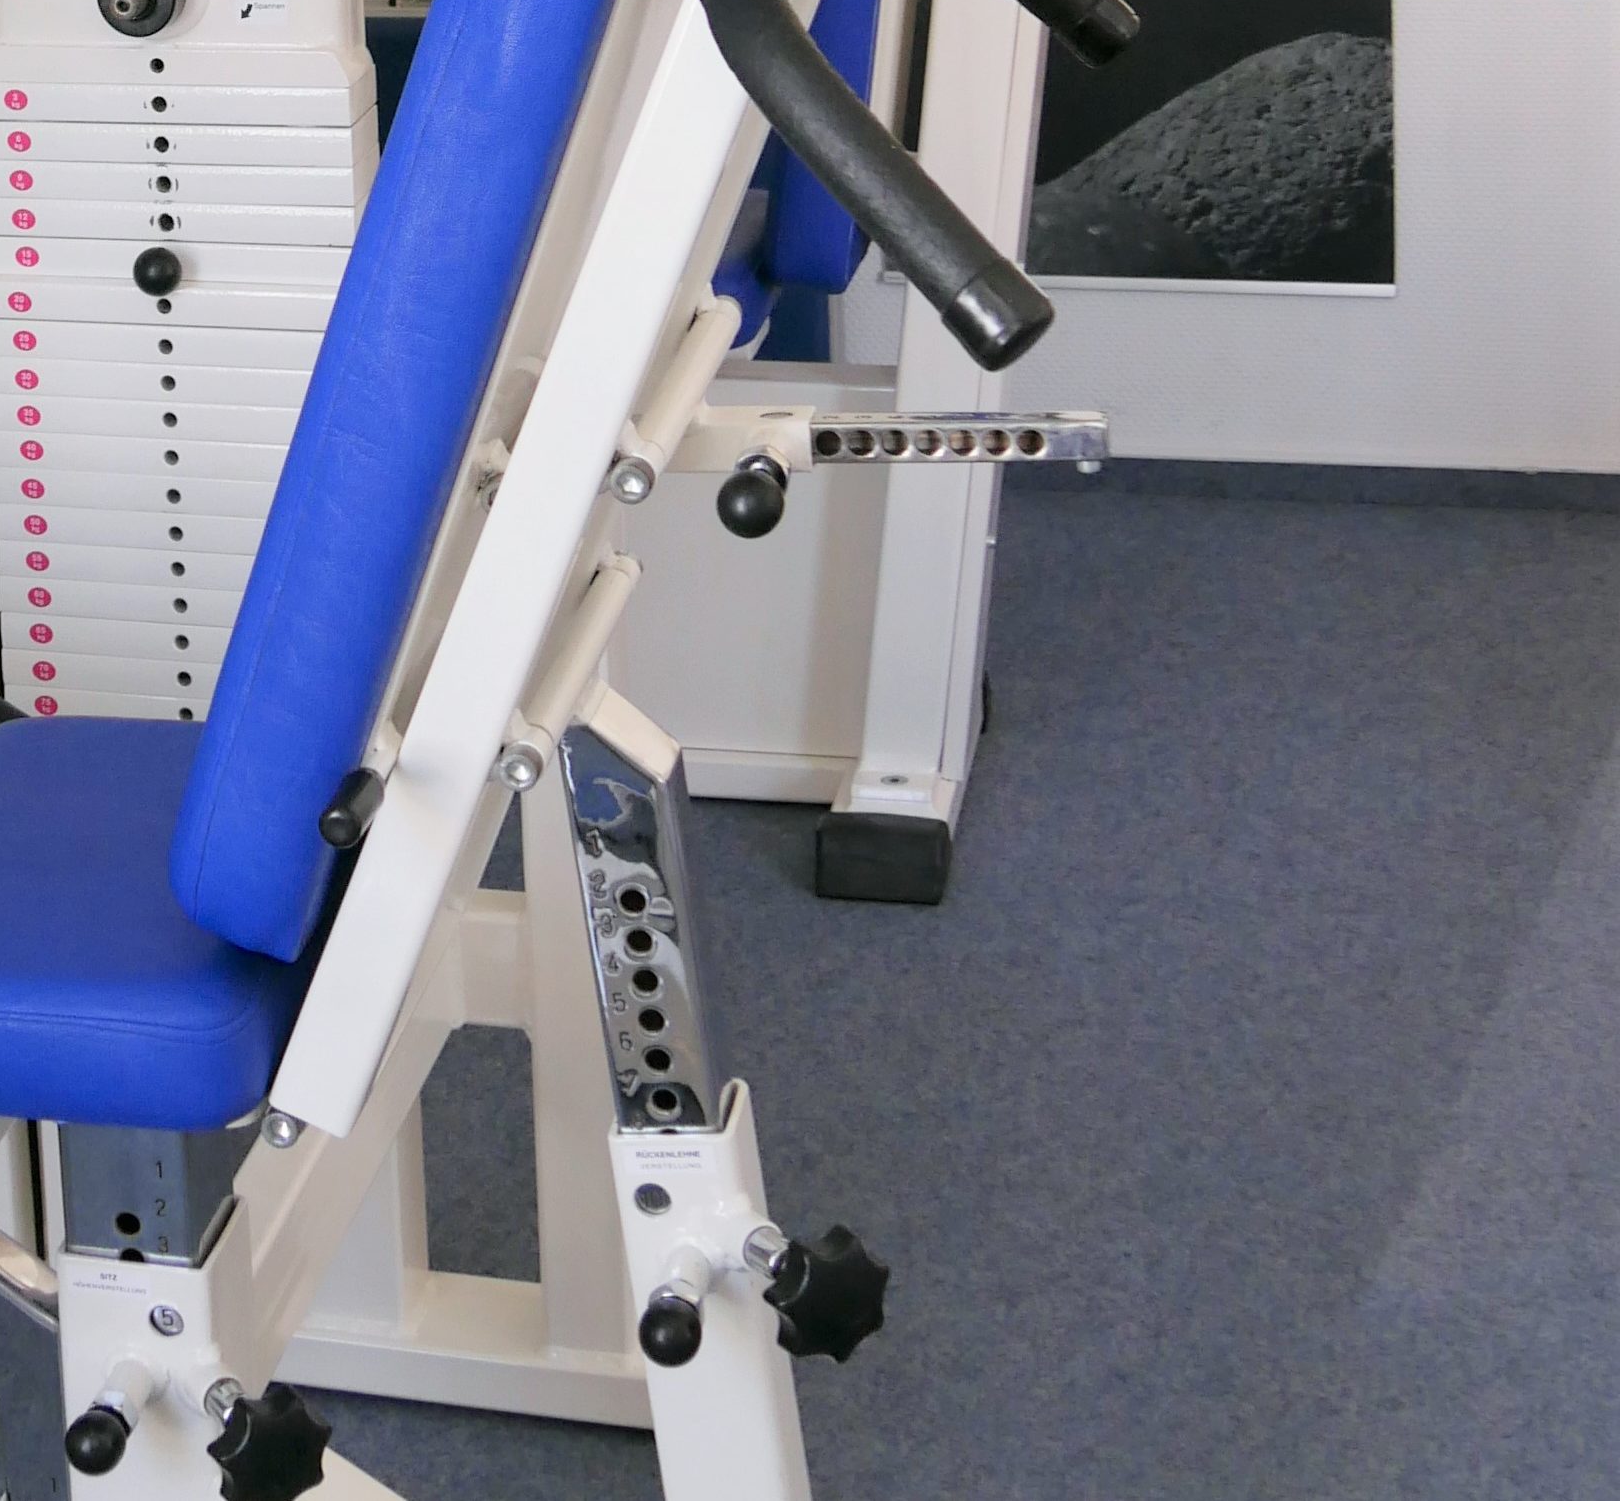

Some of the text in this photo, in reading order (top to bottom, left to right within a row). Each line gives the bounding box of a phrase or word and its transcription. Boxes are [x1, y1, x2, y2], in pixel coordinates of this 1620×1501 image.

[612, 993, 627, 1013] 5
[619, 1031, 633, 1051] 6
[156, 1160, 162, 1178] 1
[155, 1198, 167, 1217] 2
[158, 1236, 168, 1253] 3
[161, 1309, 174, 1326] 5
